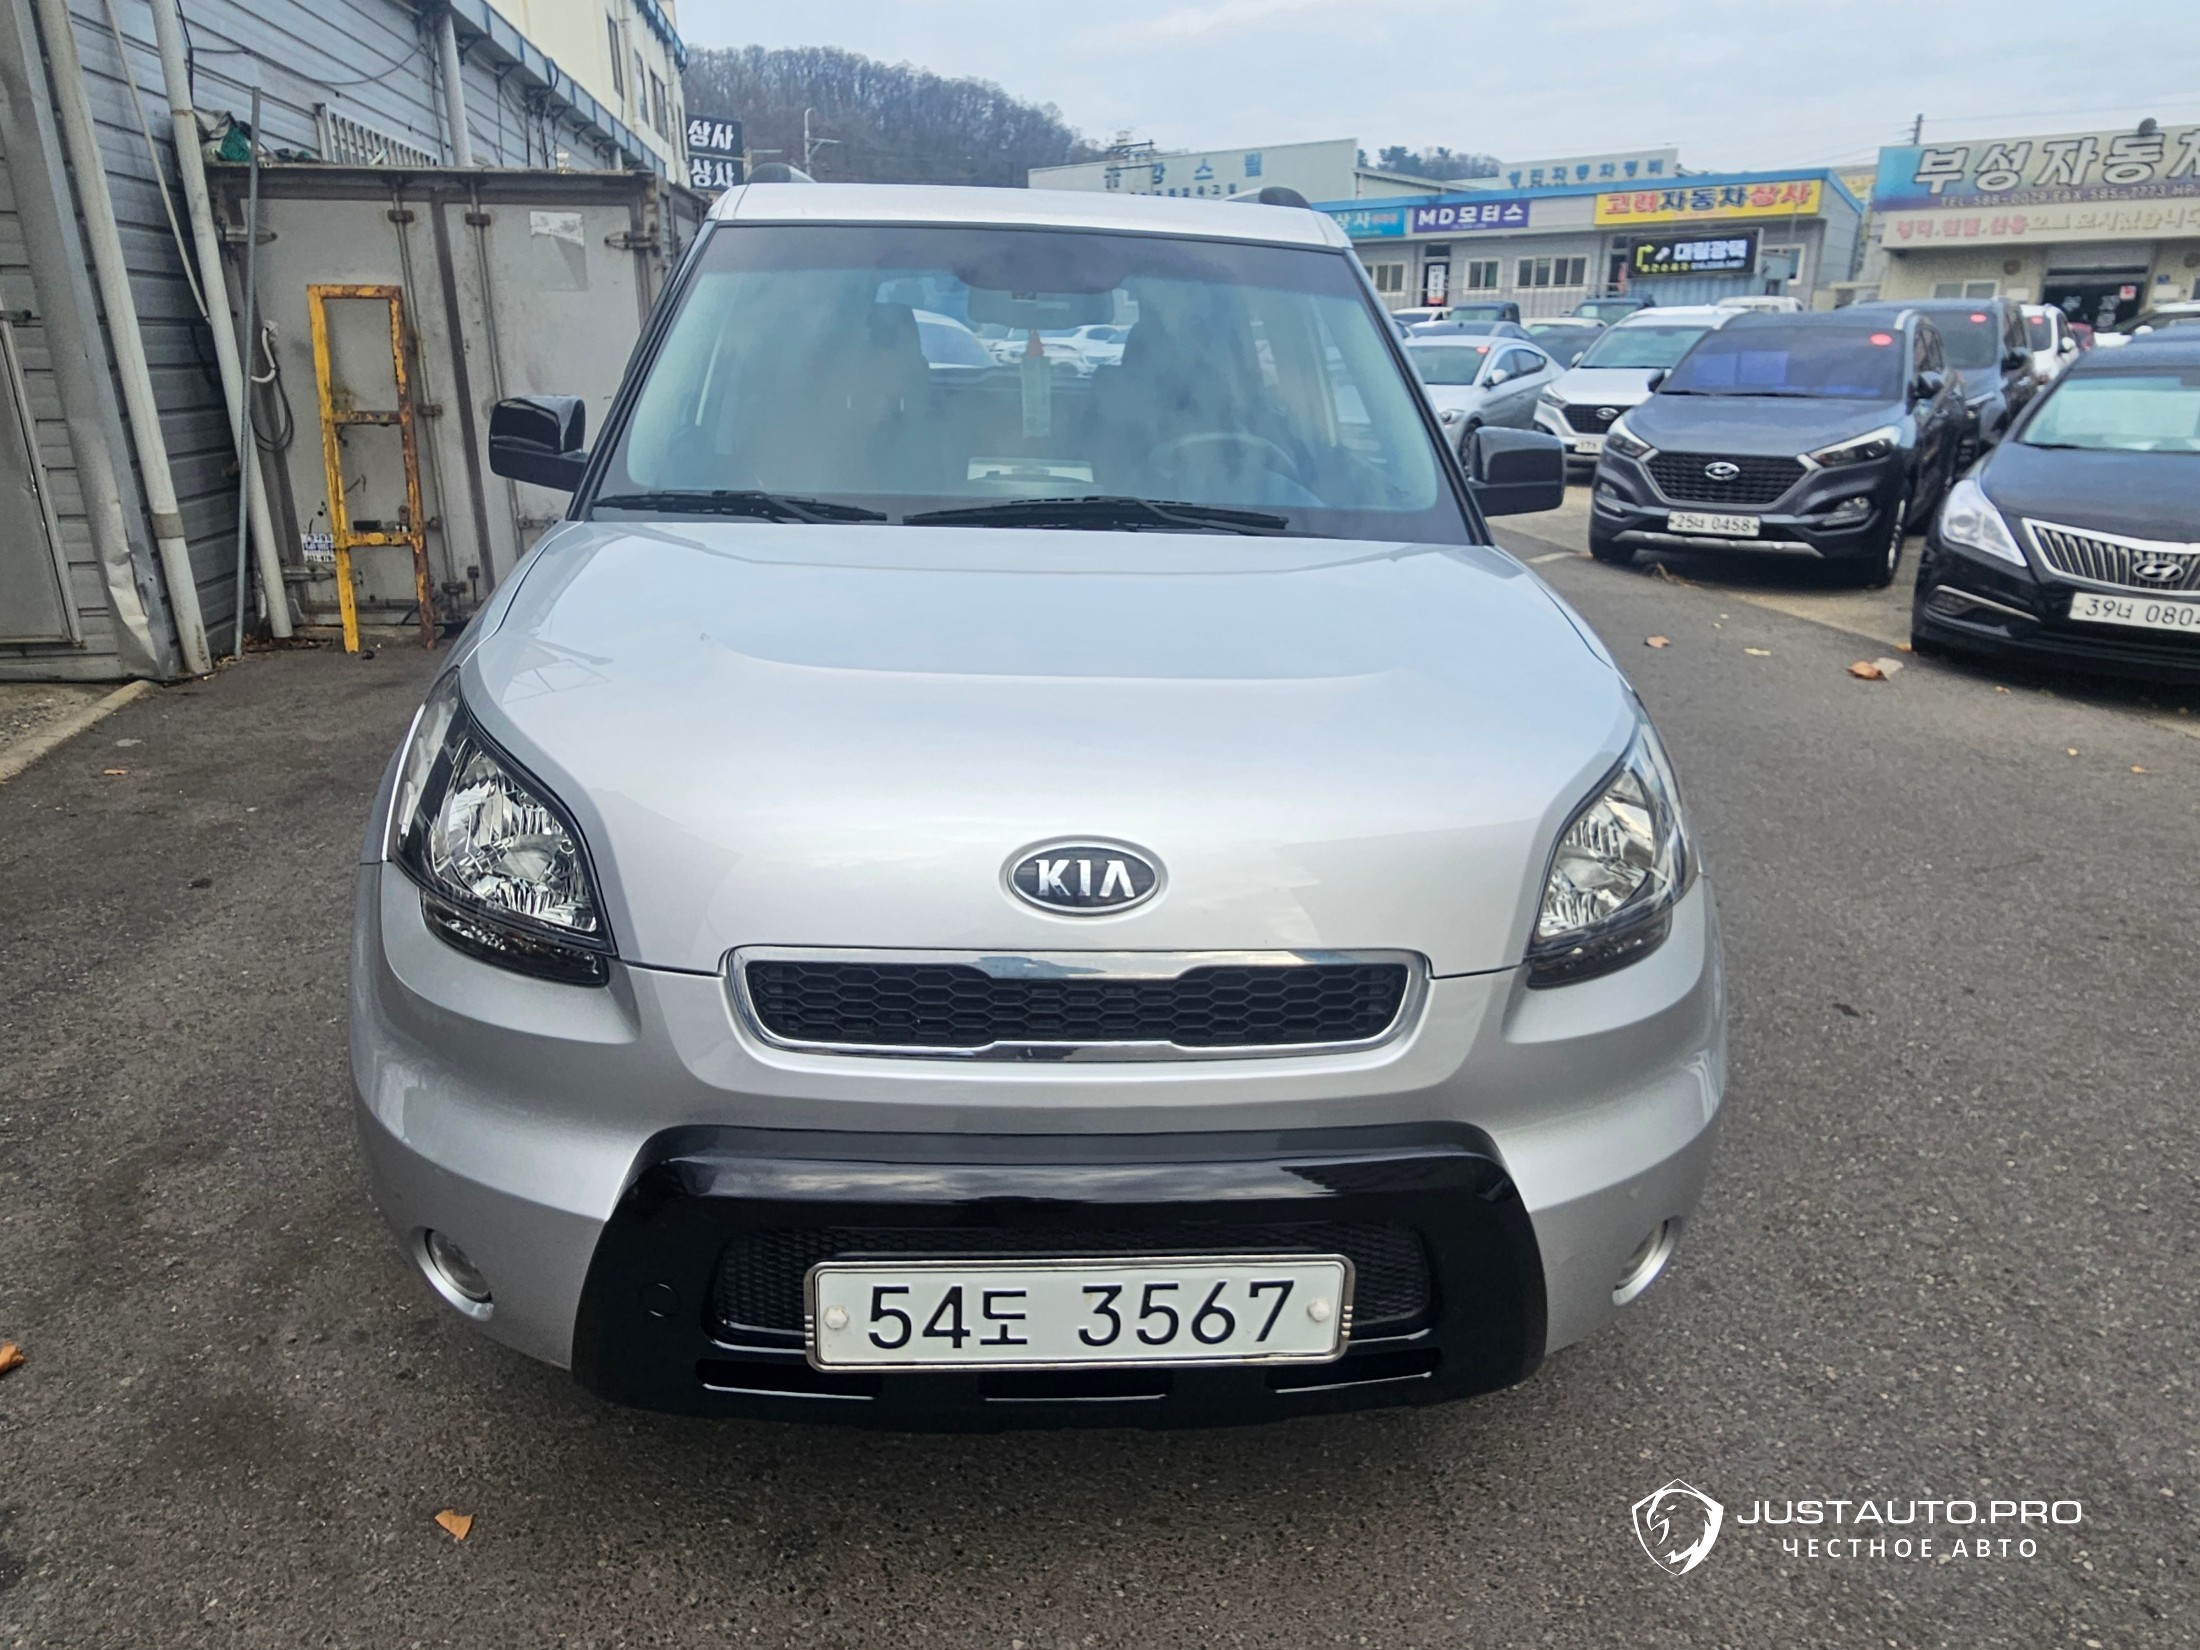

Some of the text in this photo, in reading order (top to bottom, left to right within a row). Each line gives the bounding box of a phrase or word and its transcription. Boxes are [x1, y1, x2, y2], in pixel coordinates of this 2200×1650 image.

[688, 120, 734, 150] 상사
[690, 159, 735, 188] 상사
[1606, 184, 1811, 215] 고려자동차상사
[1418, 204, 1524, 226] MD모터스
[1711, 516, 1751, 532] 0458
[2085, 598, 2134, 620] 39너
[1035, 859, 1135, 898] KIA
[868, 1280, 1295, 1350] 54도 3567
